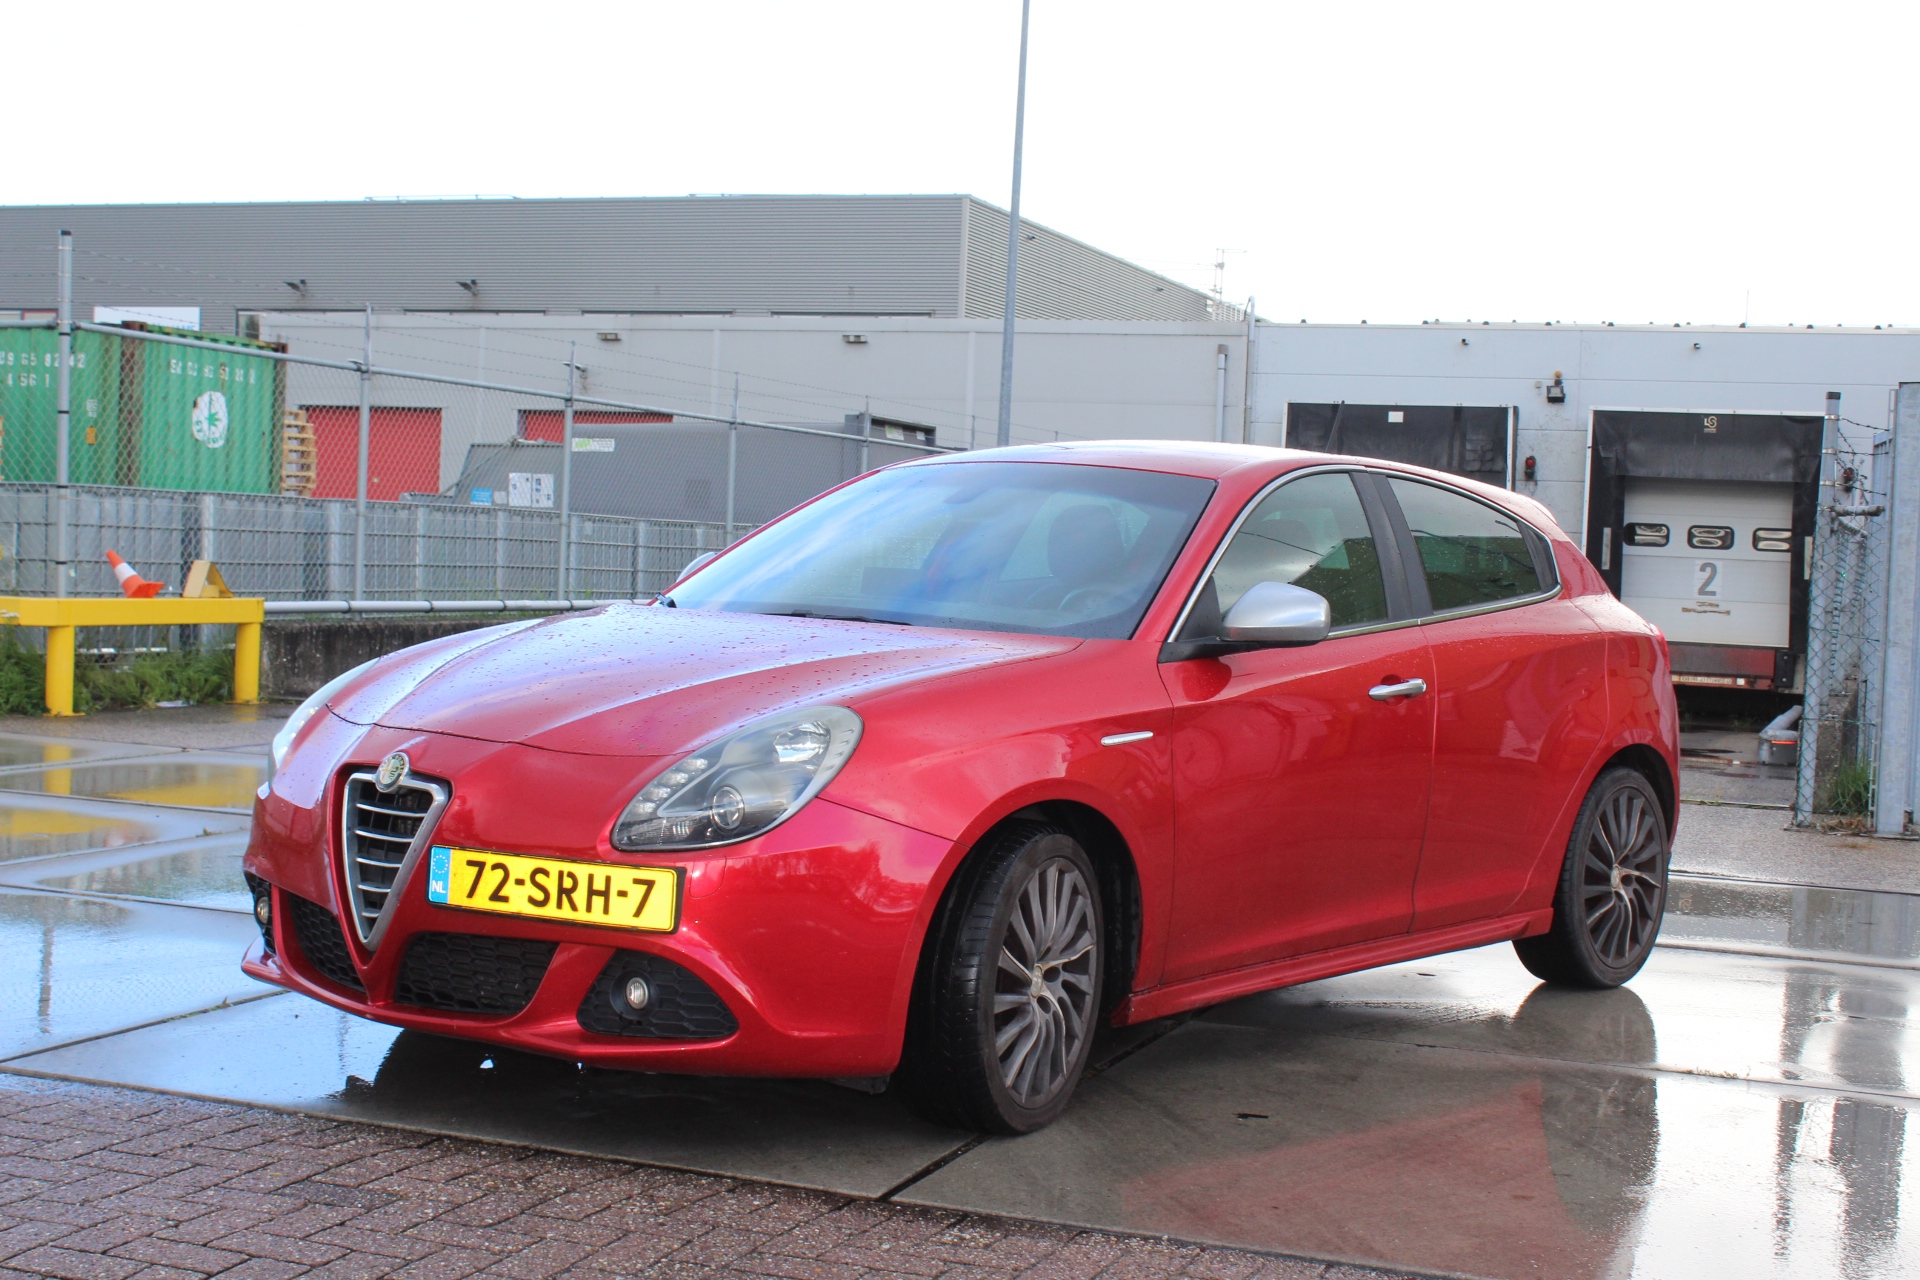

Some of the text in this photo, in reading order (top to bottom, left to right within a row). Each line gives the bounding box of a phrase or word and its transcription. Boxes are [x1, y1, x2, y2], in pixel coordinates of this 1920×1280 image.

[1698, 562, 1717, 596] 2
[431, 880, 446, 894] NL
[465, 859, 656, 918] 72-SRH-7
